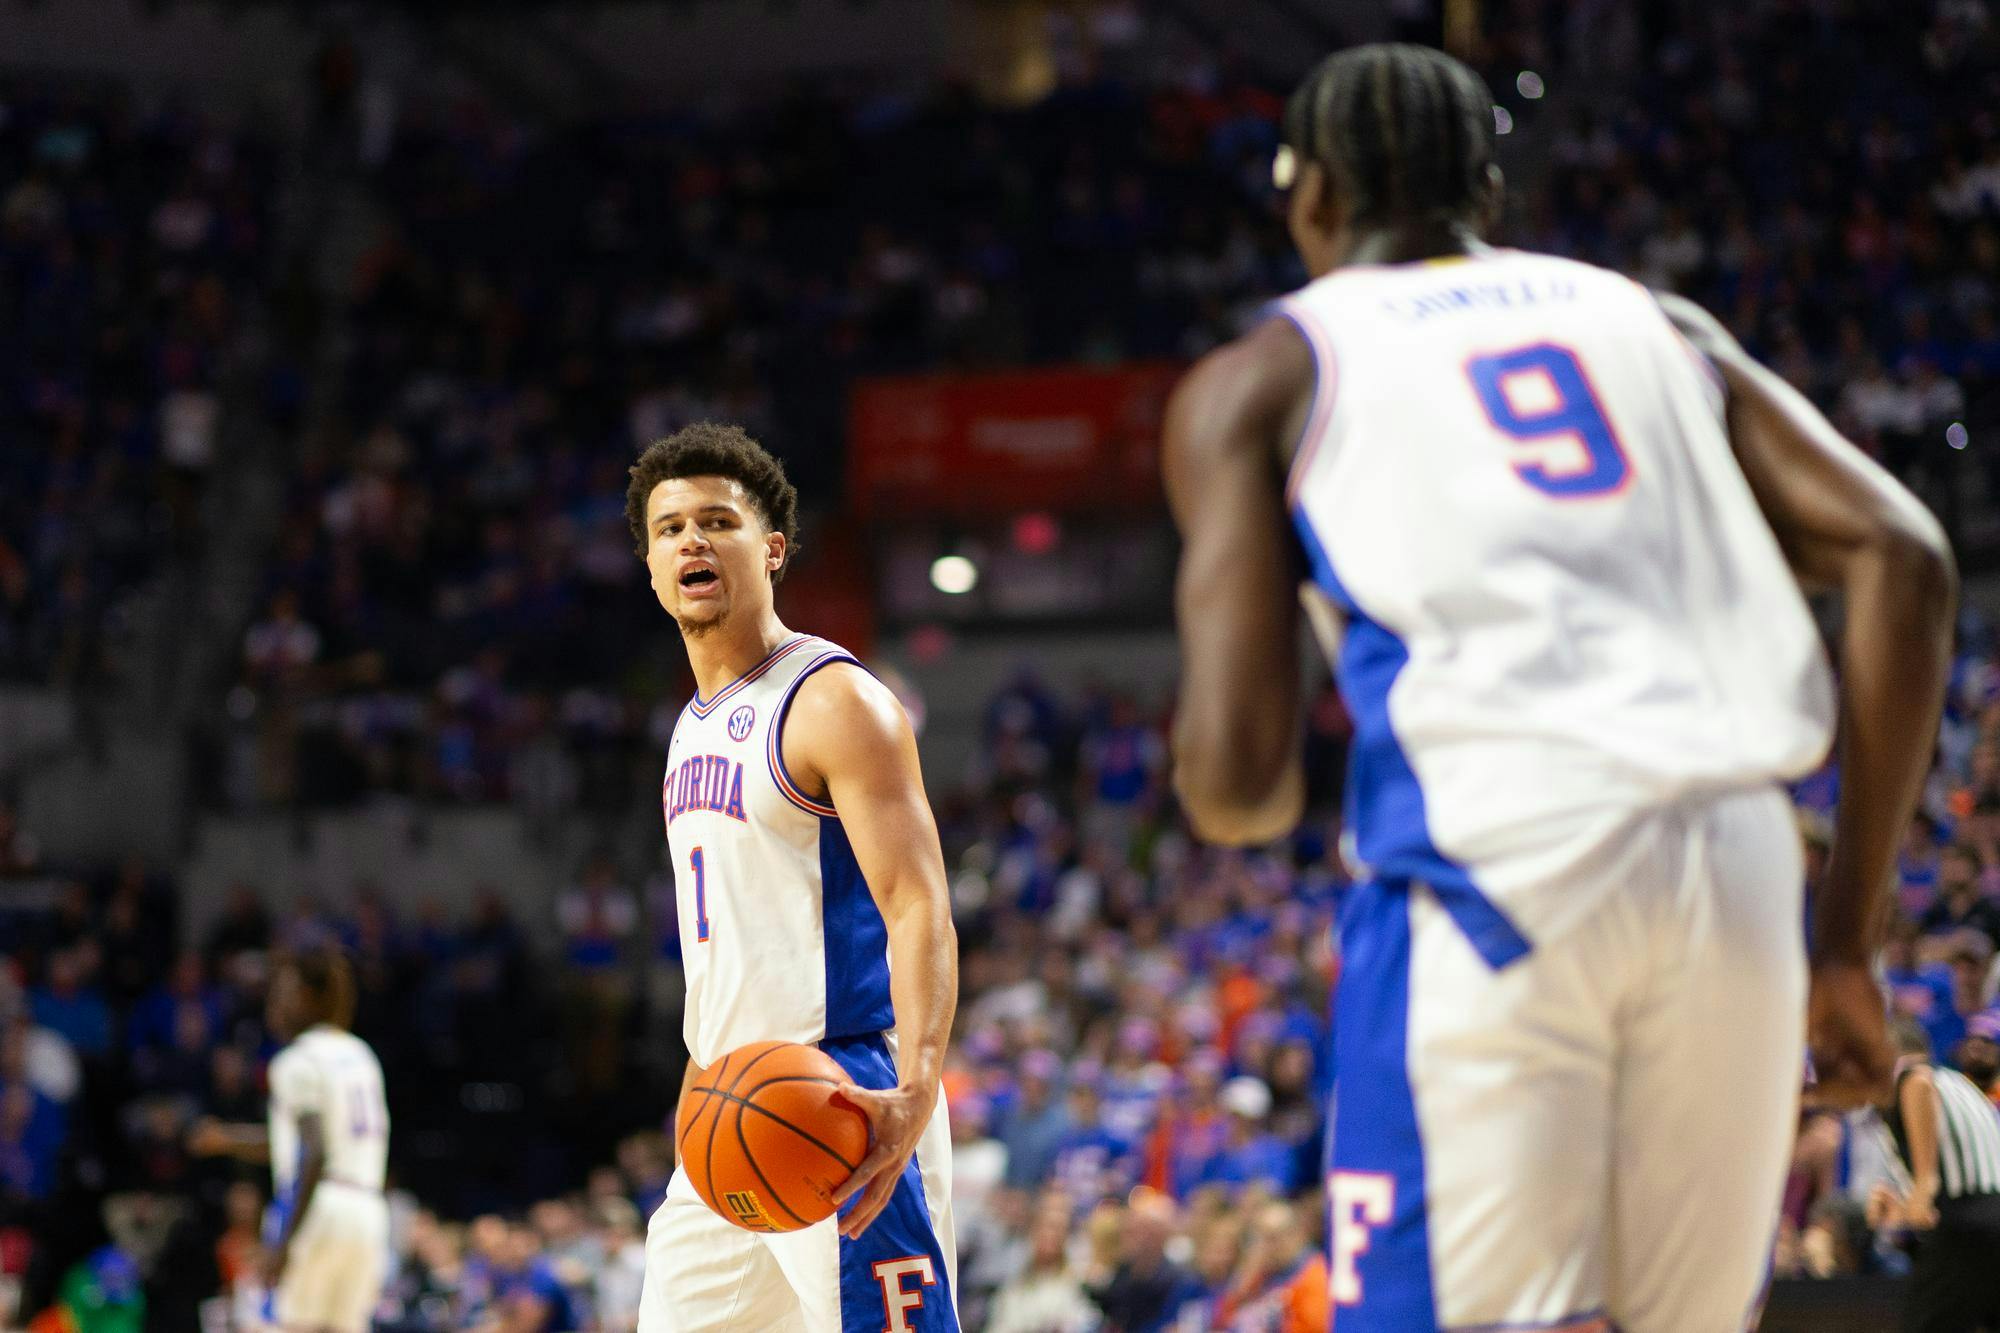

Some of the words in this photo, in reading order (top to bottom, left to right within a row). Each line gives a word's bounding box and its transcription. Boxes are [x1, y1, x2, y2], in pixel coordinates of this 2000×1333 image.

[1462, 341, 1633, 499] 9
[691, 846, 709, 942] 1
[871, 1254, 937, 1333] F
[1327, 1168, 1396, 1307] F
